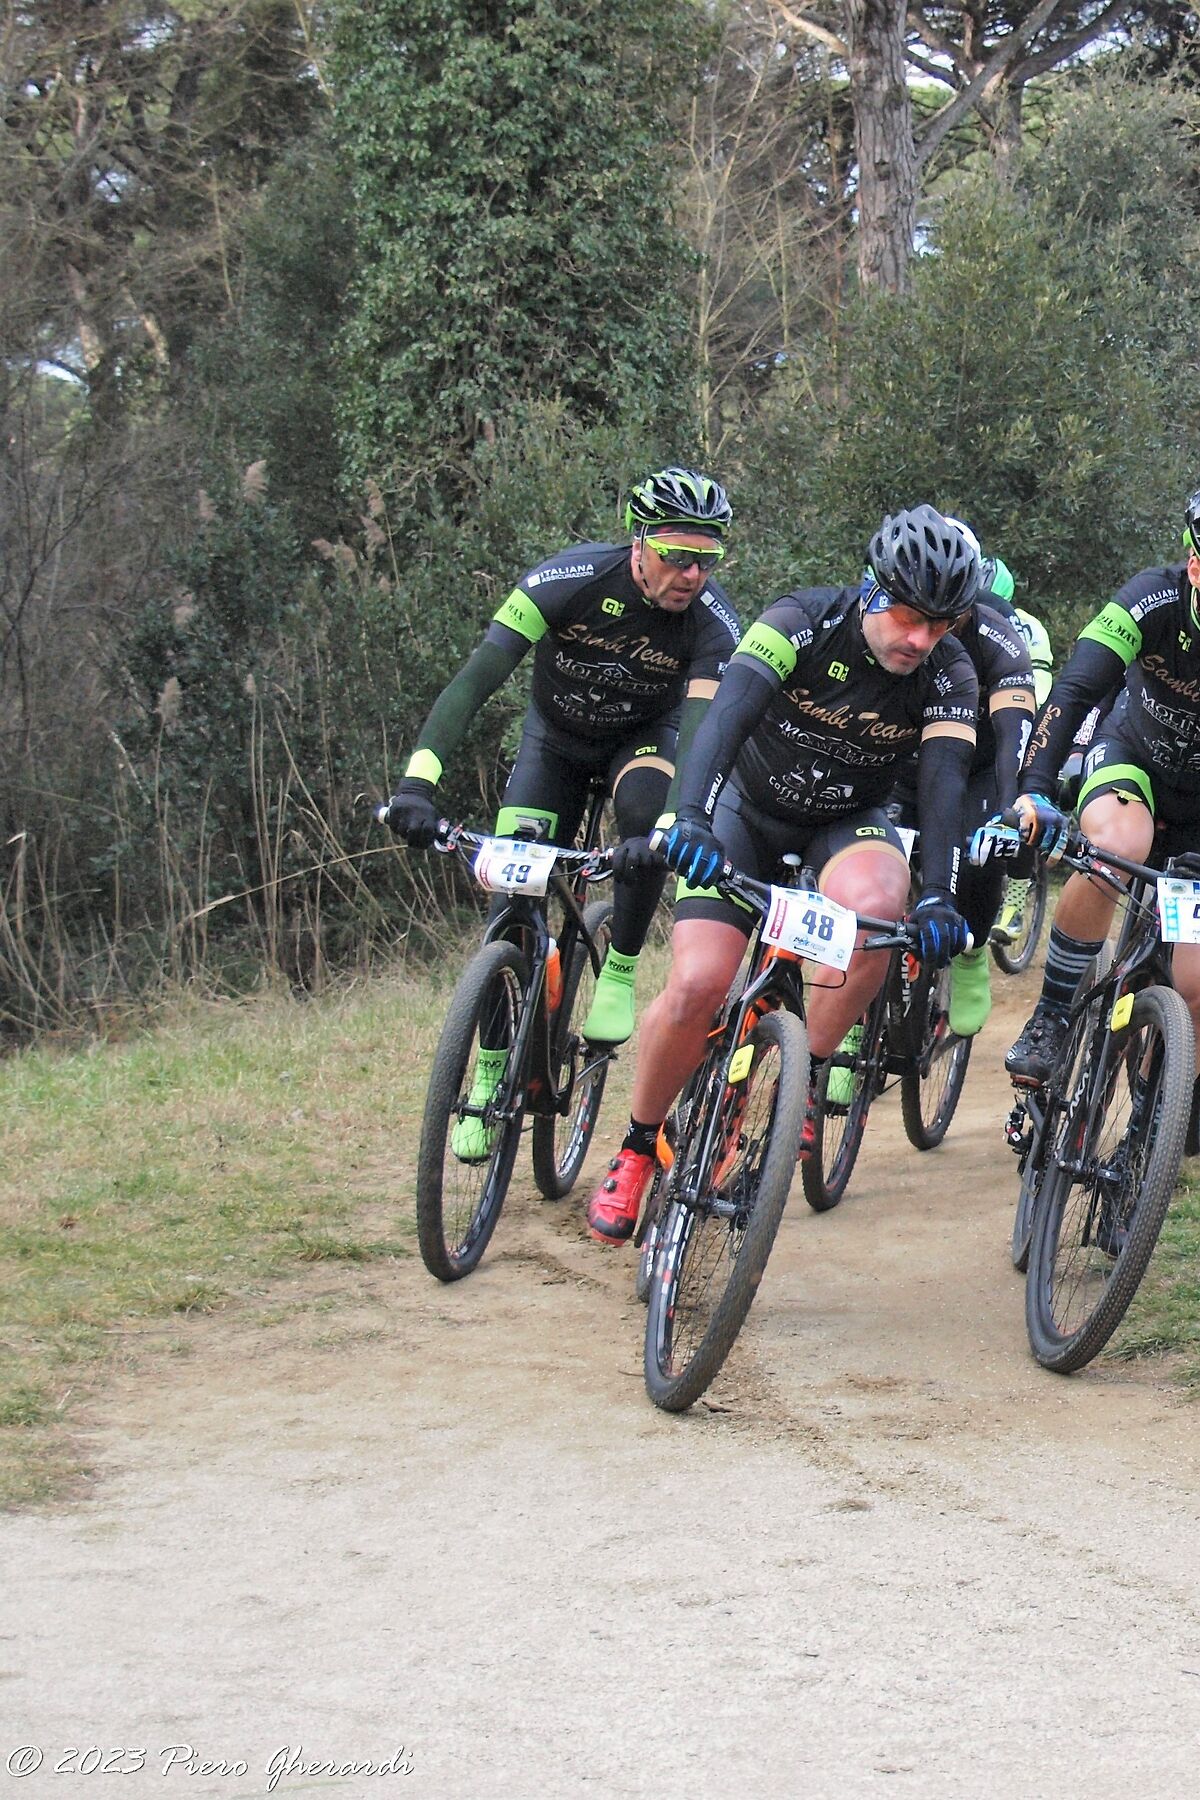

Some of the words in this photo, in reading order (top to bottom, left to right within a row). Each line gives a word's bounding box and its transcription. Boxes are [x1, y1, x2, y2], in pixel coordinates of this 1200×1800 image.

[540, 564, 594, 577] ITALIANA
[988, 629, 1021, 657] ITALIANA
[1114, 625, 1138, 646] MAX
[782, 687, 853, 729] Sambi
[950, 705, 975, 718] MAX
[1035, 703, 1061, 736] Sambi
[1024, 737, 1048, 768] Team
[501, 862, 532, 884] 49
[801, 909, 835, 942] 48
